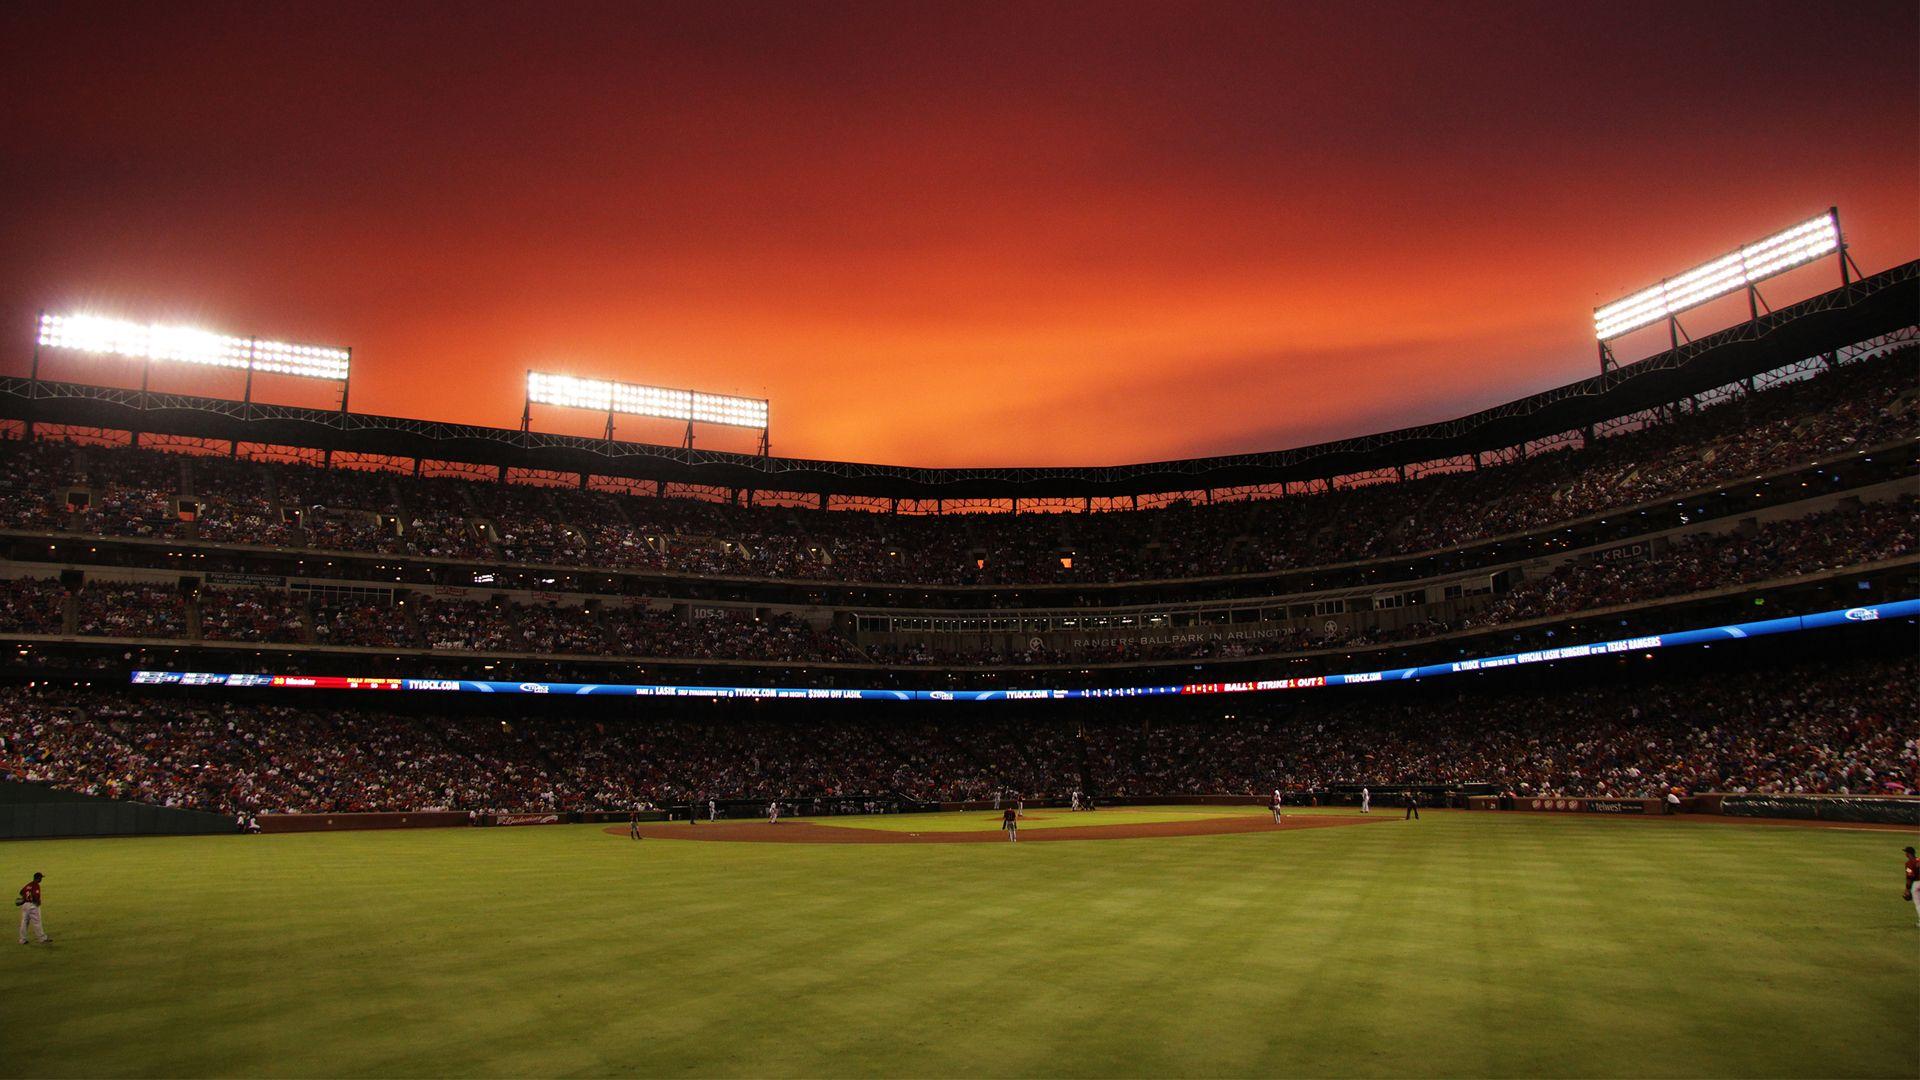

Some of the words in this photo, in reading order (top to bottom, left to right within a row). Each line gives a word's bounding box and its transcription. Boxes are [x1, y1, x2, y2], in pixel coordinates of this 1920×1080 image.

[1602, 545, 1642, 560] KRLD
[694, 608, 725, 619] 105.3
[1073, 638, 1134, 647] RANGERS
[1140, 634, 1204, 645] BALLPARK
[1227, 627, 1296, 640] ARLINGTON
[1518, 652, 1542, 663] OFFICIAL
[1543, 650, 1560, 660] LASIK
[1561, 646, 1590, 658] SURGEON
[1607, 641, 1627, 652] TEXAS
[1628, 637, 1661, 649] RANGERS
[1344, 672, 1382, 683] TYLOCK.COM
[409, 680, 459, 690] TYLOCK.COM
[1224, 683, 1247, 691] BALL
[1257, 680, 1288, 690] STRIKE
[1298, 678, 1316, 687] OUT
[656, 686, 676, 695] LASIK
[735, 688, 777, 697] TYLOCK.COM
[808, 689, 830, 698] $2000
[831, 690, 842, 698] OFF
[1006, 690, 1048, 699] TYLOCK.COM
